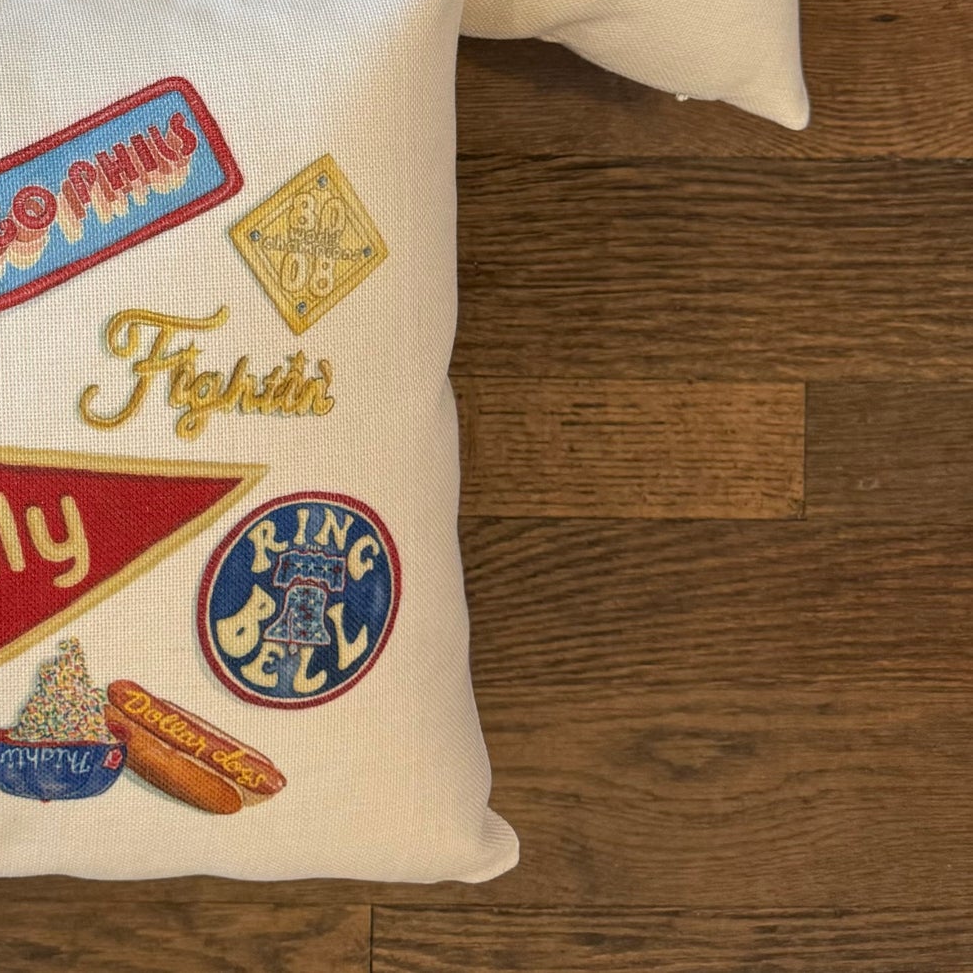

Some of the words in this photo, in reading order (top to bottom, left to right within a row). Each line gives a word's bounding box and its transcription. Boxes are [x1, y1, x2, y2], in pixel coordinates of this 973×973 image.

[62, 111, 198, 224] PHILS
[247, 508, 380, 580] RING
[216, 584, 369, 694] BELL
[124, 690, 207, 756] Dollar
